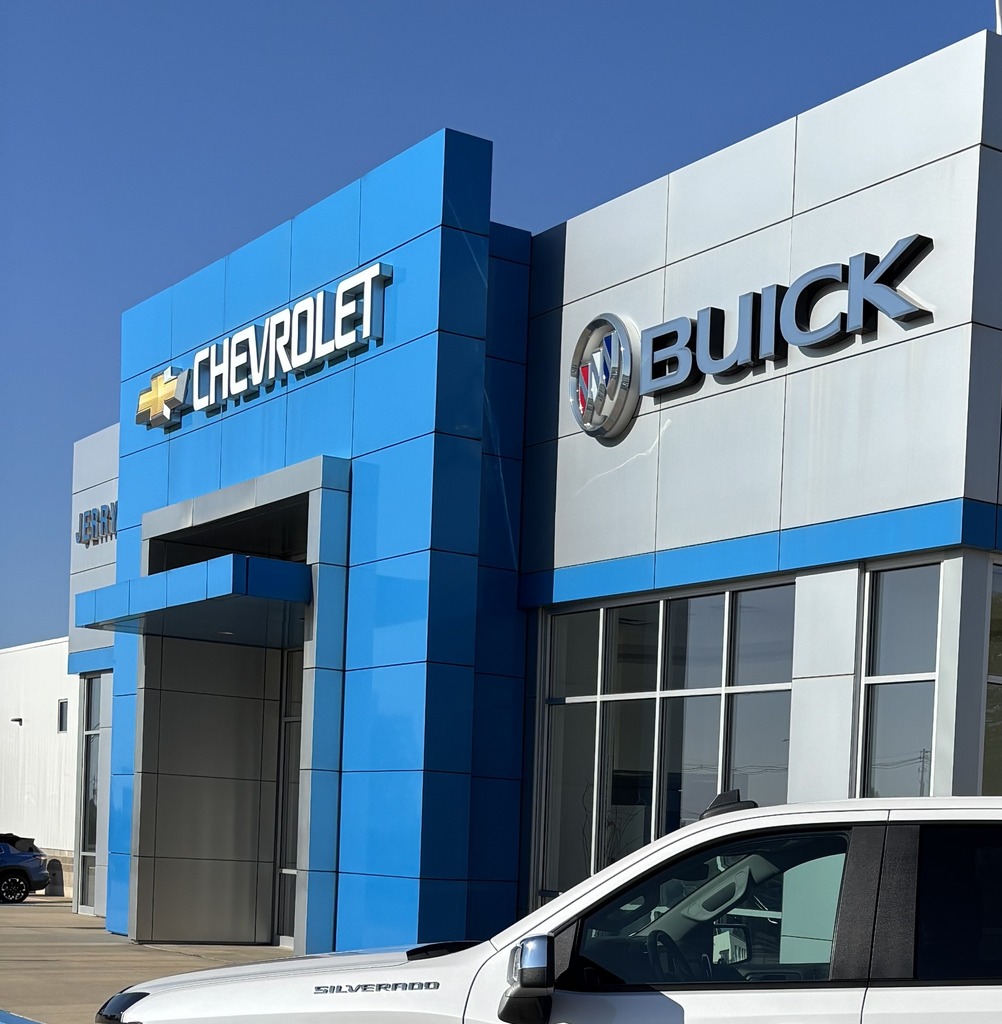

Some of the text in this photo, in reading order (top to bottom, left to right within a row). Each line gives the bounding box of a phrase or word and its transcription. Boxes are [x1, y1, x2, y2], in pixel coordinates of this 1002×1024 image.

[193, 262, 390, 412] CHEVROLET
[640, 233, 933, 397] BUICK
[313, 981, 440, 994] SILVERADO
